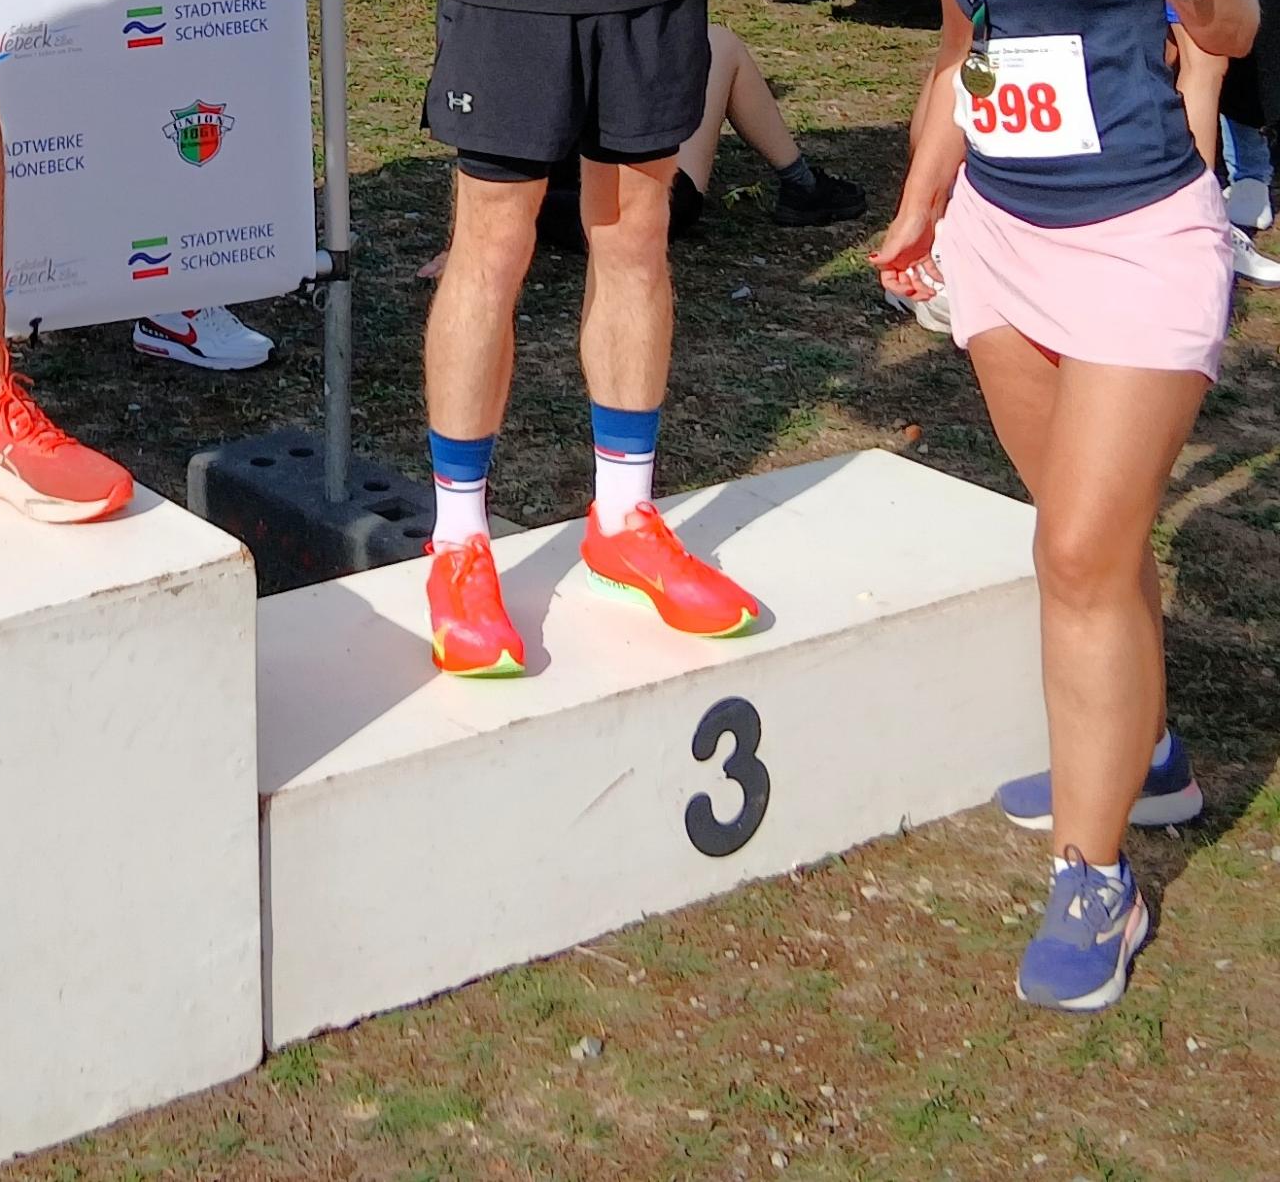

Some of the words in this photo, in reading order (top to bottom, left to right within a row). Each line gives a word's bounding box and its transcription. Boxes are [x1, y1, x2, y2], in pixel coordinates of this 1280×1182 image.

[175, 16, 269, 41] SCHÖNEBECK
[173, 114, 226, 129] UNION
[971, 82, 1062, 134] 598
[180, 223, 274, 249] STADTWERKE
[180, 242, 276, 271] SCHÖNEBECK
[684, 696, 772, 857] 3
